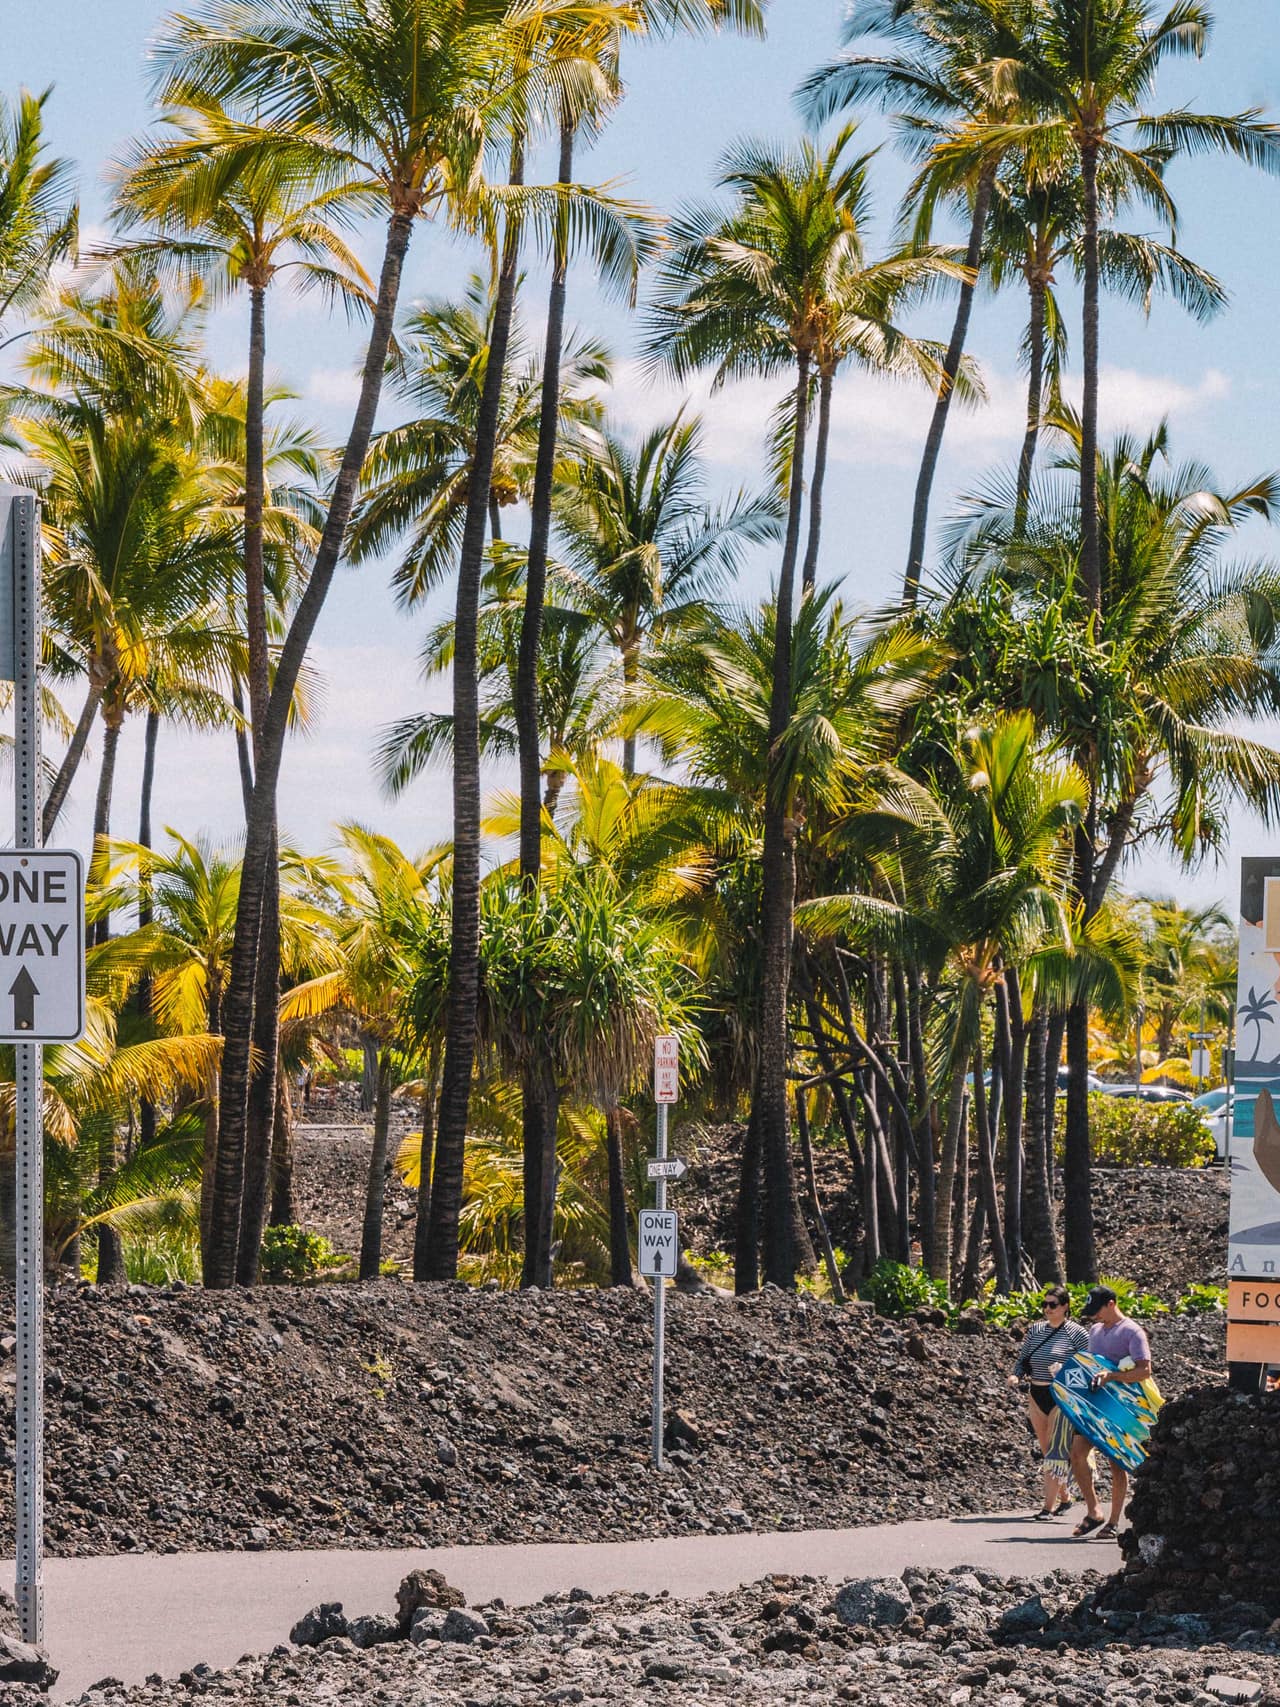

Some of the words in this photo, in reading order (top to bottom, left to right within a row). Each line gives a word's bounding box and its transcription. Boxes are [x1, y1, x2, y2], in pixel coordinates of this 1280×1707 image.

[662, 1042, 672, 1055] NO
[663, 1163, 677, 1176] WAY
[644, 1217, 672, 1229] ONE
[644, 1235, 672, 1247] WAY
